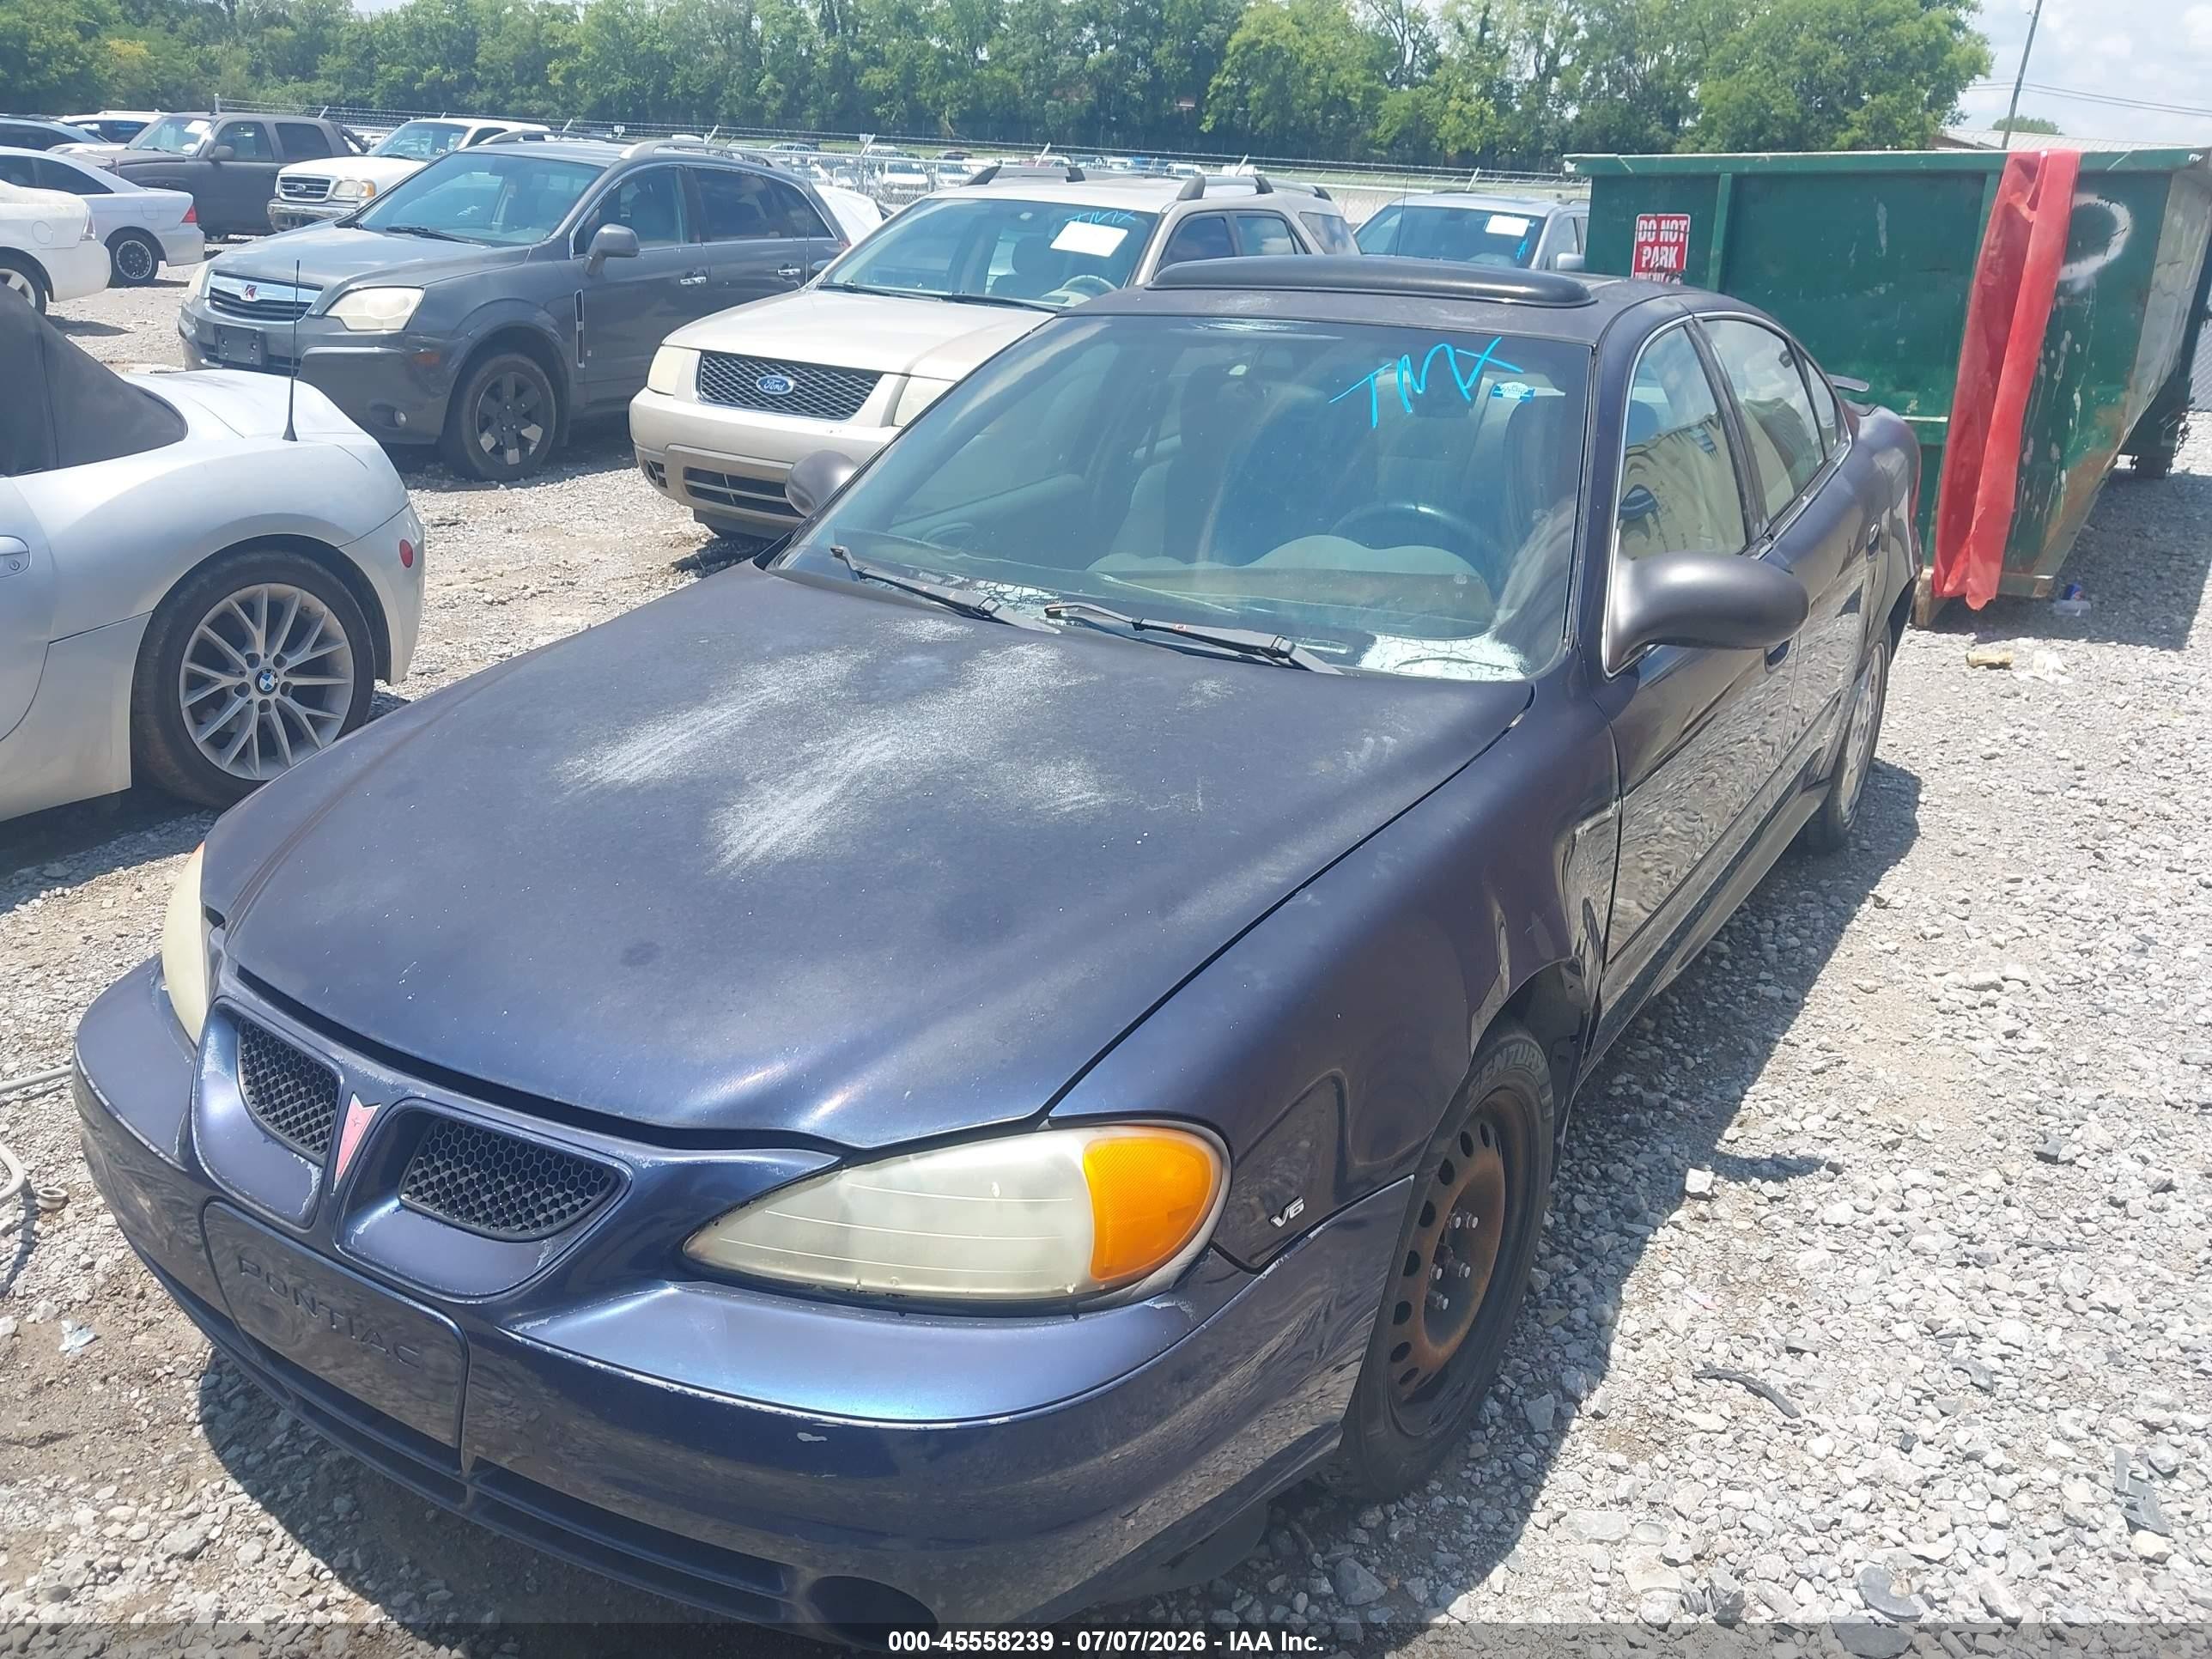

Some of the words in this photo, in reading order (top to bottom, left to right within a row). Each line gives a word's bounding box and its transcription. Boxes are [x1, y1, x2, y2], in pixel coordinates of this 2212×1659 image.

[1638, 219, 1657, 243] DO
[1659, 219, 1687, 243] NOT
[1641, 246, 1680, 269] PARK
[1329, 337, 1524, 428] TMX
[1270, 1197, 1304, 1228] V6
[238, 1255, 421, 1369] PONTIAC
